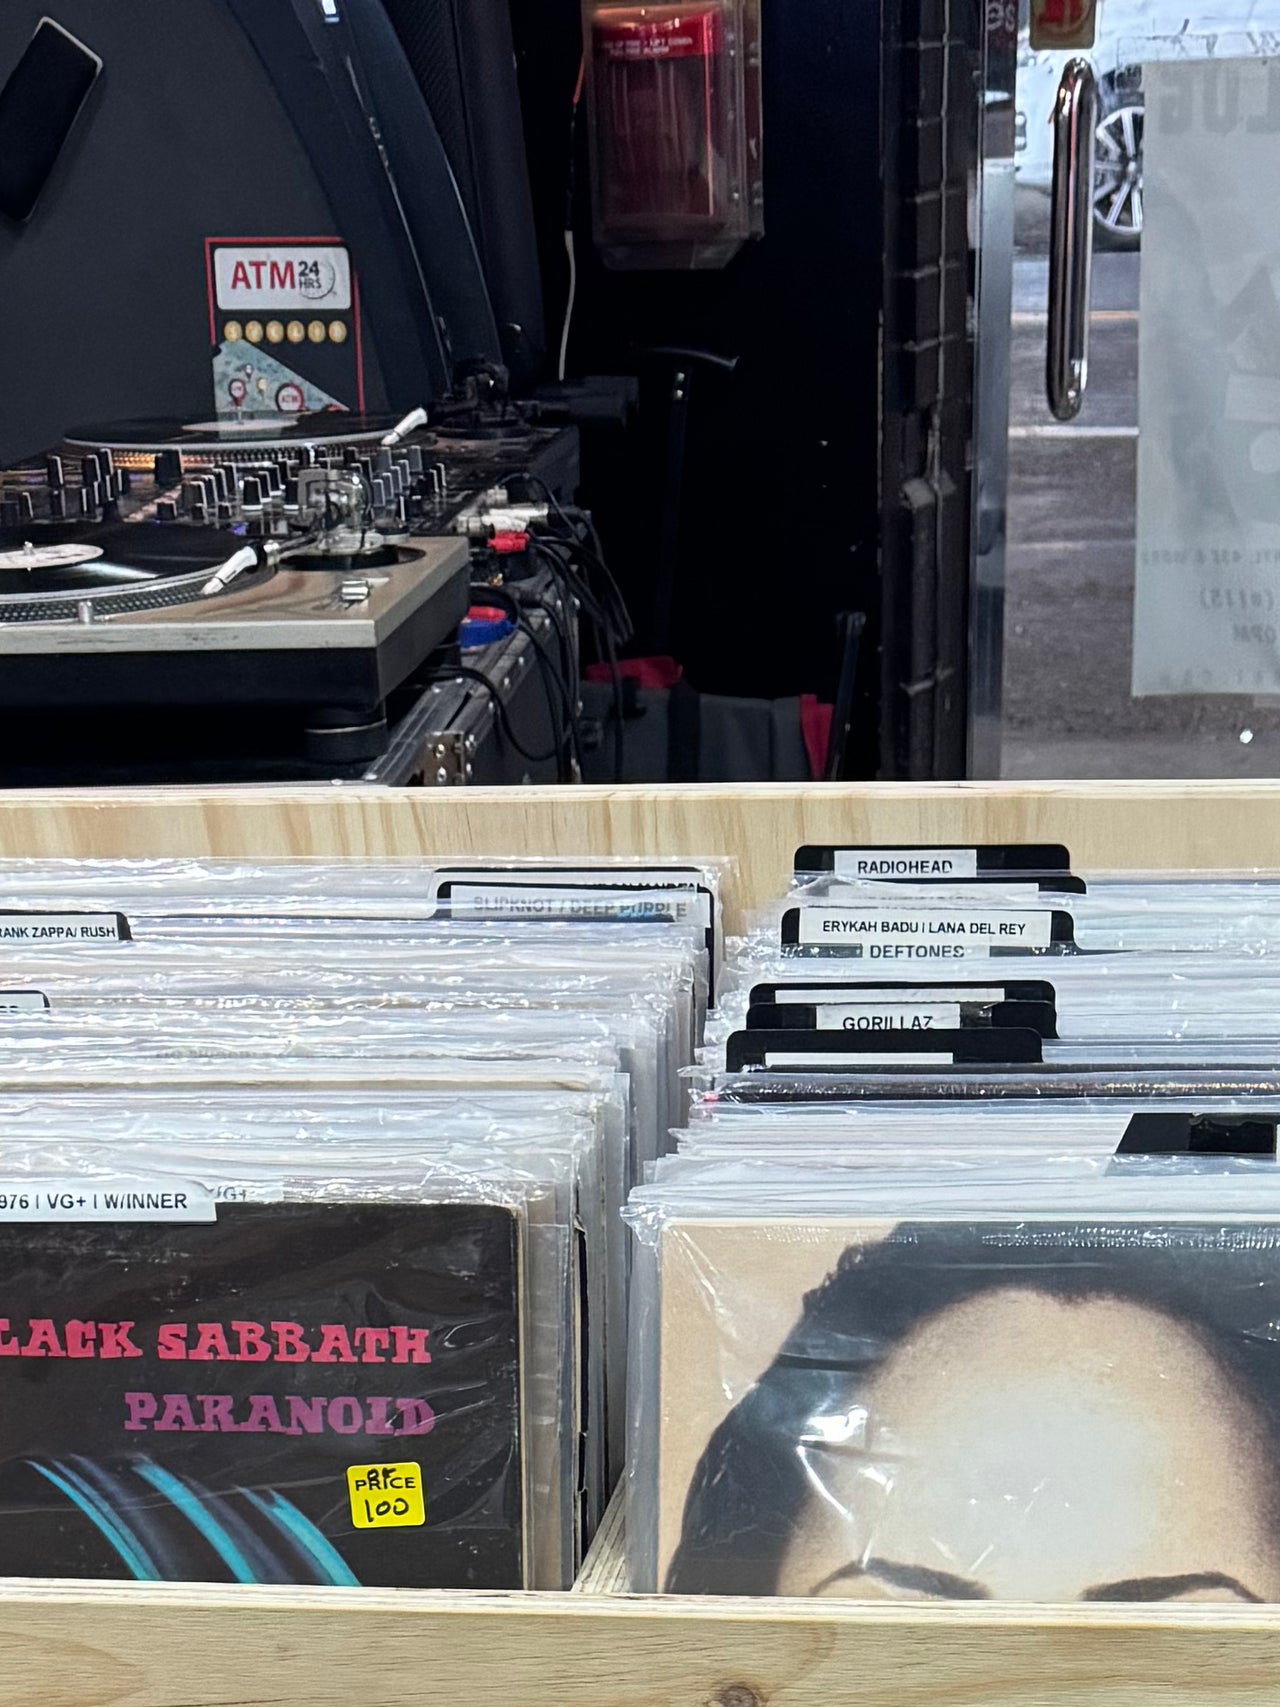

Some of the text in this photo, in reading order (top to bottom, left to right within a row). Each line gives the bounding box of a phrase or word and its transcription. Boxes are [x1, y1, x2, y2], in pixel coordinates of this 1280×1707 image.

[230, 260, 320, 290] ATM 24
[298, 277, 323, 290] HRS
[856, 859, 954, 875] RADIOHEAD
[473, 895, 554, 913] SLIPKNOT
[571, 898, 614, 916] DEEP
[80, 926, 116, 939] RUSH
[822, 919, 878, 934] ERYKAH
[880, 920, 920, 935] BADU
[928, 921, 968, 936] LANA
[969, 922, 997, 936] DEL
[998, 922, 1027, 936] REY
[869, 944, 966, 960] DEFTONES
[842, 1014, 935, 1031] GORILLAZ
[46, 1193, 87, 1210] VG+
[104, 1192, 188, 1210] W/INNER
[157, 1320, 432, 1364] SABBATH
[124, 1391, 435, 1436] PARANOID
[355, 1476, 416, 1492] PRICE
[365, 1497, 410, 1523] 100
